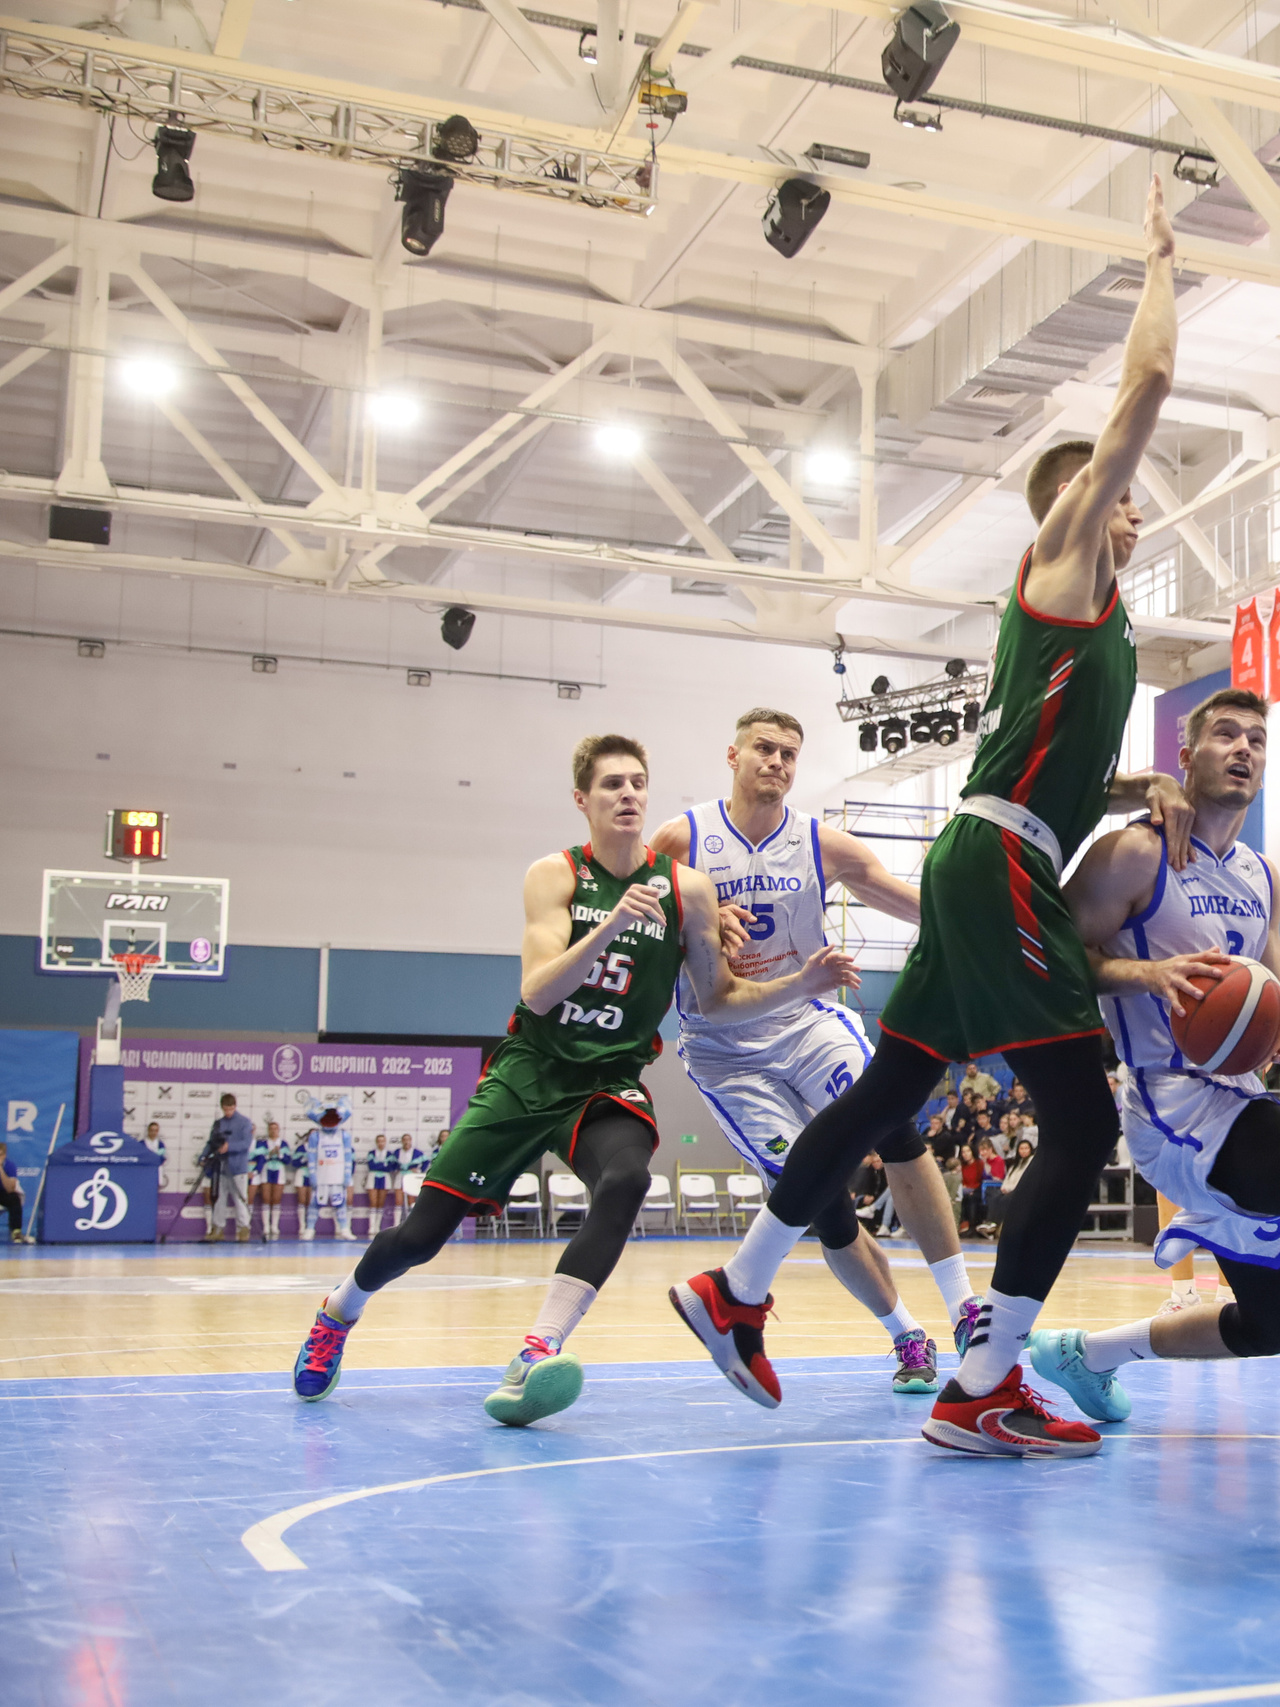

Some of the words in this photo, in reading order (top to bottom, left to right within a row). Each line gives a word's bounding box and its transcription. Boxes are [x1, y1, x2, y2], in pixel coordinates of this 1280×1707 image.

[1241, 637, 1253, 668] 4
[134, 829, 160, 856] 11
[106, 893, 169, 911] PARI
[216, 1053, 264, 1071] РОССИИ
[382, 1057, 453, 1075] 2022—2023
